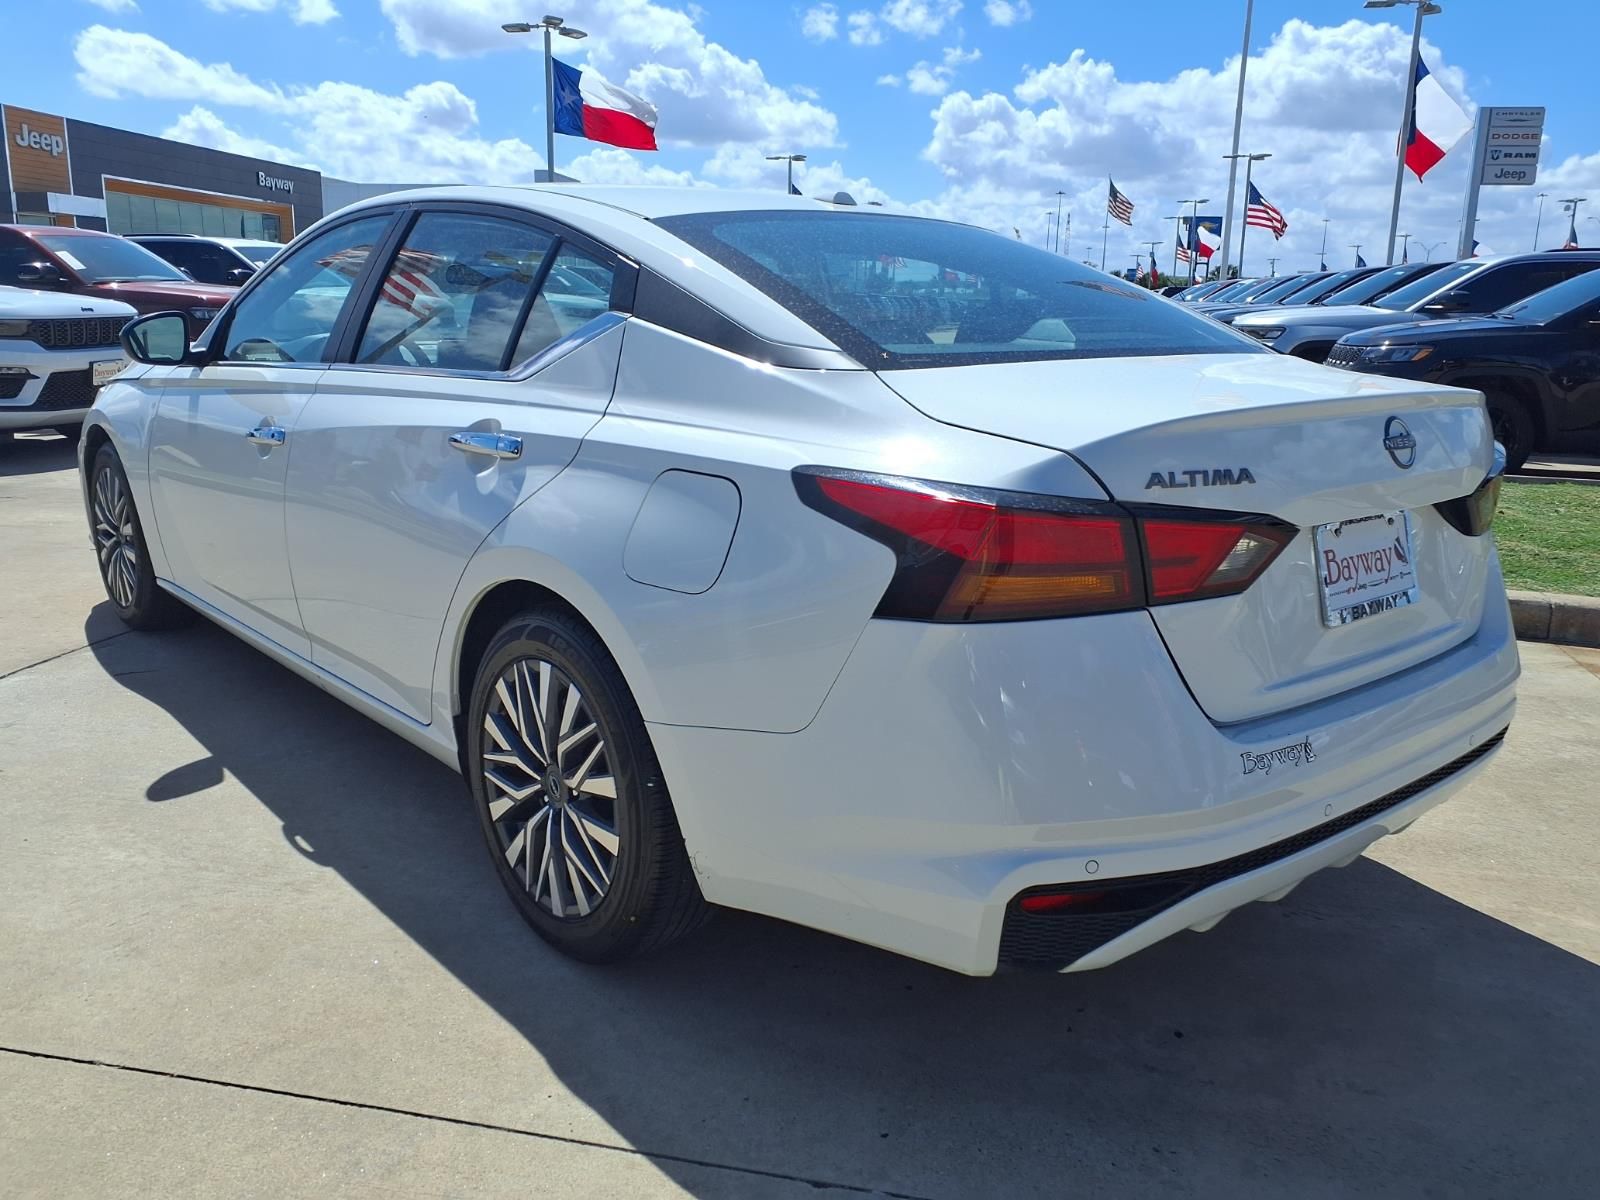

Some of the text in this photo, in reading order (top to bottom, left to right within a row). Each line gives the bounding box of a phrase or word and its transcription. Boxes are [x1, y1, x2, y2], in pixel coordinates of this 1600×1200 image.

[16, 123, 64, 157] Jeep
[257, 171, 295, 194] Bayway
[1494, 168, 1527, 181] Jeep
[1144, 468, 1256, 489] ALTIMA
[1323, 546, 1392, 593] Bayway
[1351, 594, 1398, 620] BAYWAY
[1240, 742, 1305, 775] Bayway
